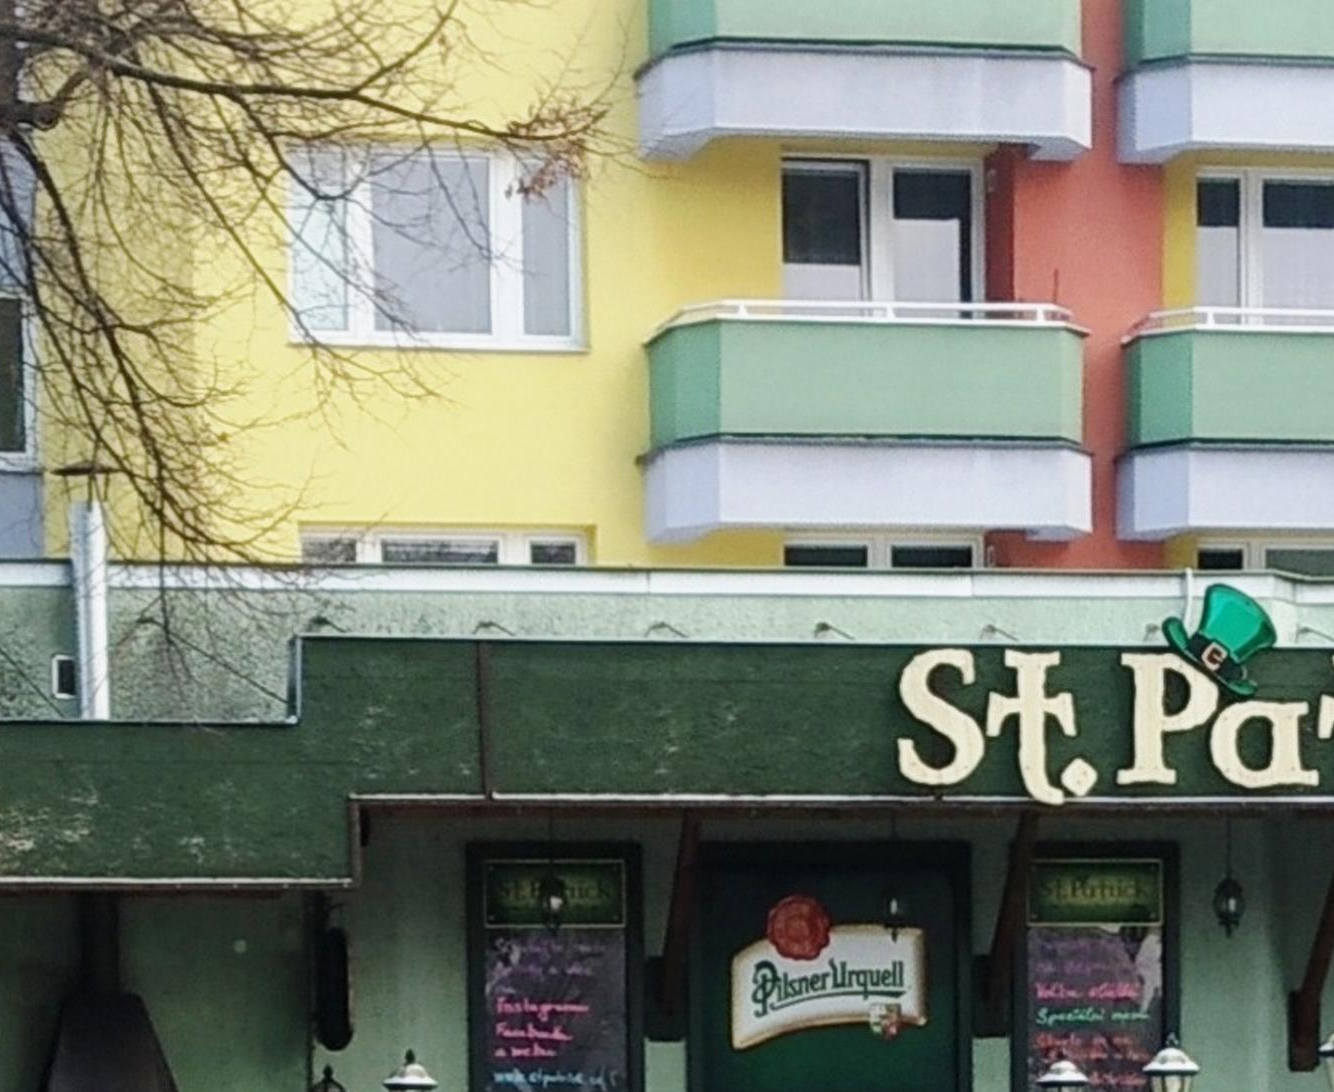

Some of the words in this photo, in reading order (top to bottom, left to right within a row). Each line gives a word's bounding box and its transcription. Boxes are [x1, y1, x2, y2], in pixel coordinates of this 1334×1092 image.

[896, 648, 1098, 807] St.
[751, 959, 831, 1018] Pilsner
[829, 958, 904, 1000] Urquell
